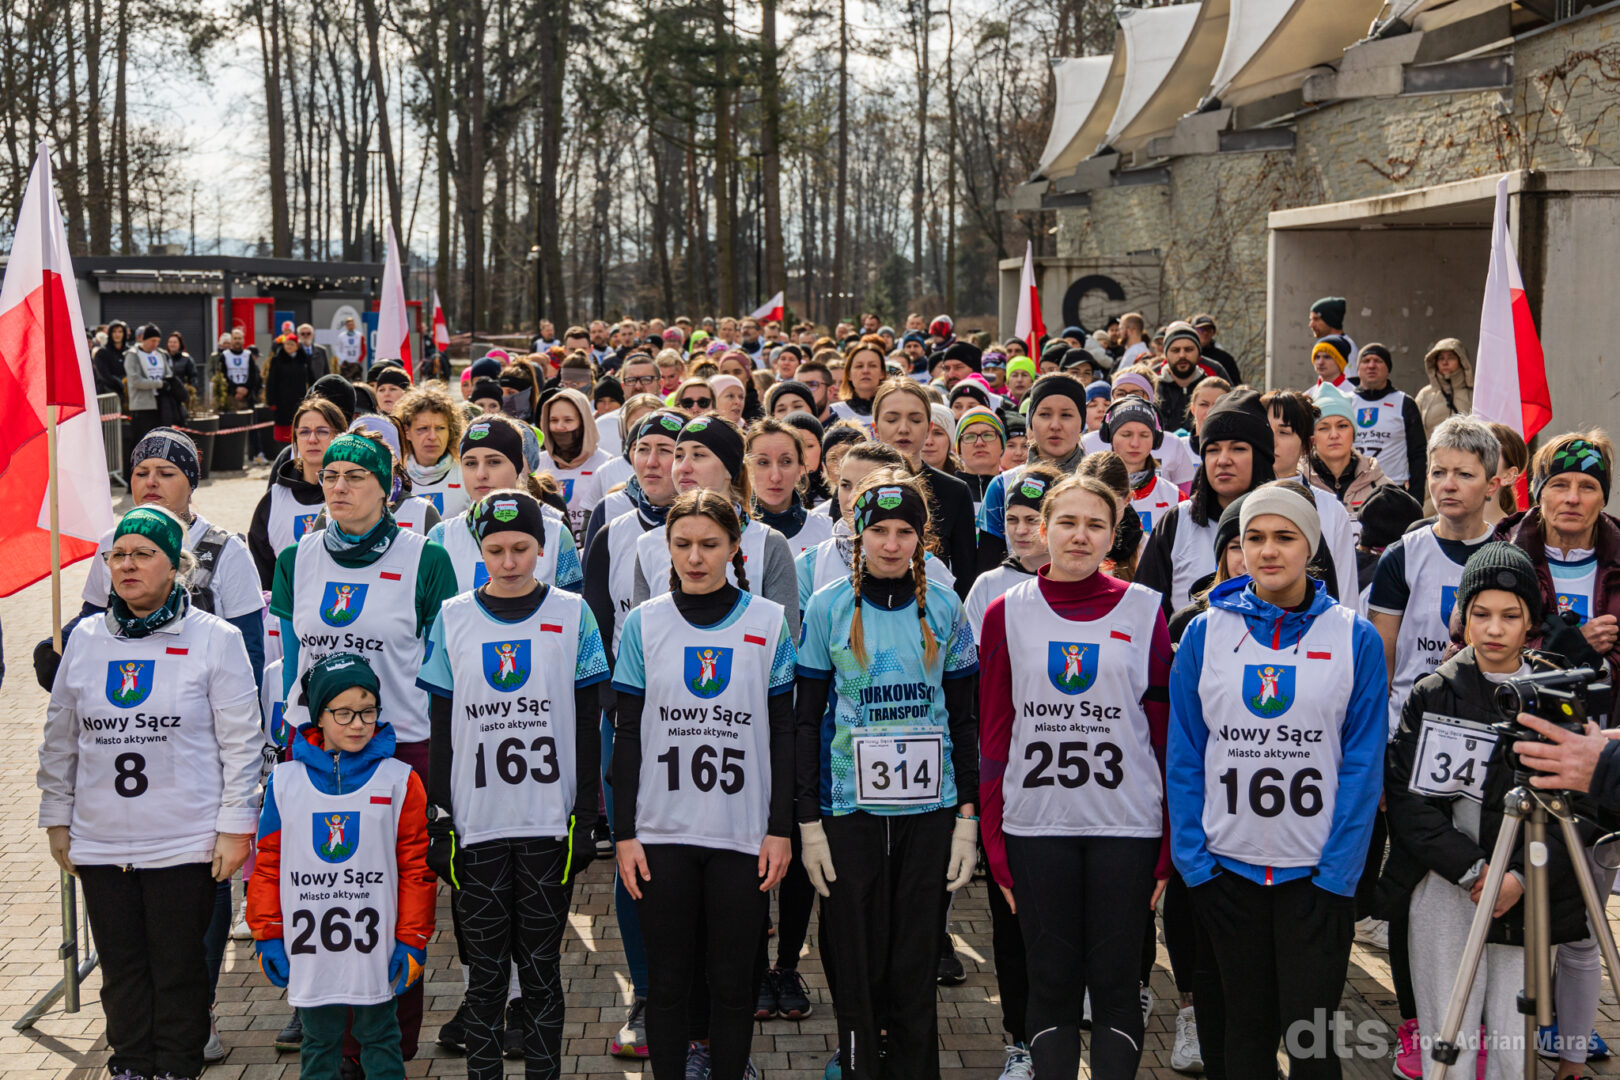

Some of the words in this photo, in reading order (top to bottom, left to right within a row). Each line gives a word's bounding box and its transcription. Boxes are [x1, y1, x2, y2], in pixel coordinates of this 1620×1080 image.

[344, 633, 383, 653] Sącz
[1417, 636, 1447, 651] Now
[465, 701, 512, 720] Nowy
[517, 696, 551, 716] Sąc
[659, 705, 708, 723] Nowy
[712, 704, 752, 726] Sącz
[1023, 701, 1075, 719] Nowy
[1080, 700, 1122, 721] Sącz
[82, 716, 129, 733] Nowy
[135, 712, 181, 732] Sącz
[480, 722, 505, 732] iasto
[507, 719, 548, 730] aktywne
[668, 726, 701, 737] Miasto
[703, 726, 739, 739] aktywne
[1035, 722, 1067, 733] Miasto
[1069, 723, 1111, 734] aktywne
[95, 736, 122, 744] Miasto
[124, 734, 168, 744] aktywne
[1217, 725, 1271, 745] Nowy
[1277, 724, 1323, 746] Sącz
[474, 735, 560, 789] 163
[1227, 748, 1261, 758] Miasto
[1263, 748, 1311, 760] aktywne
[114, 752, 149, 798] 8
[657, 744, 746, 795] 165
[871, 759, 931, 790] 314
[1022, 741, 1124, 789] 253
[1219, 767, 1324, 818] 166
[290, 871, 339, 888] Nowy
[343, 868, 384, 888] Sącz
[300, 891, 331, 901] Miasto
[332, 889, 370, 900] aktywne
[290, 906, 380, 955] 263
